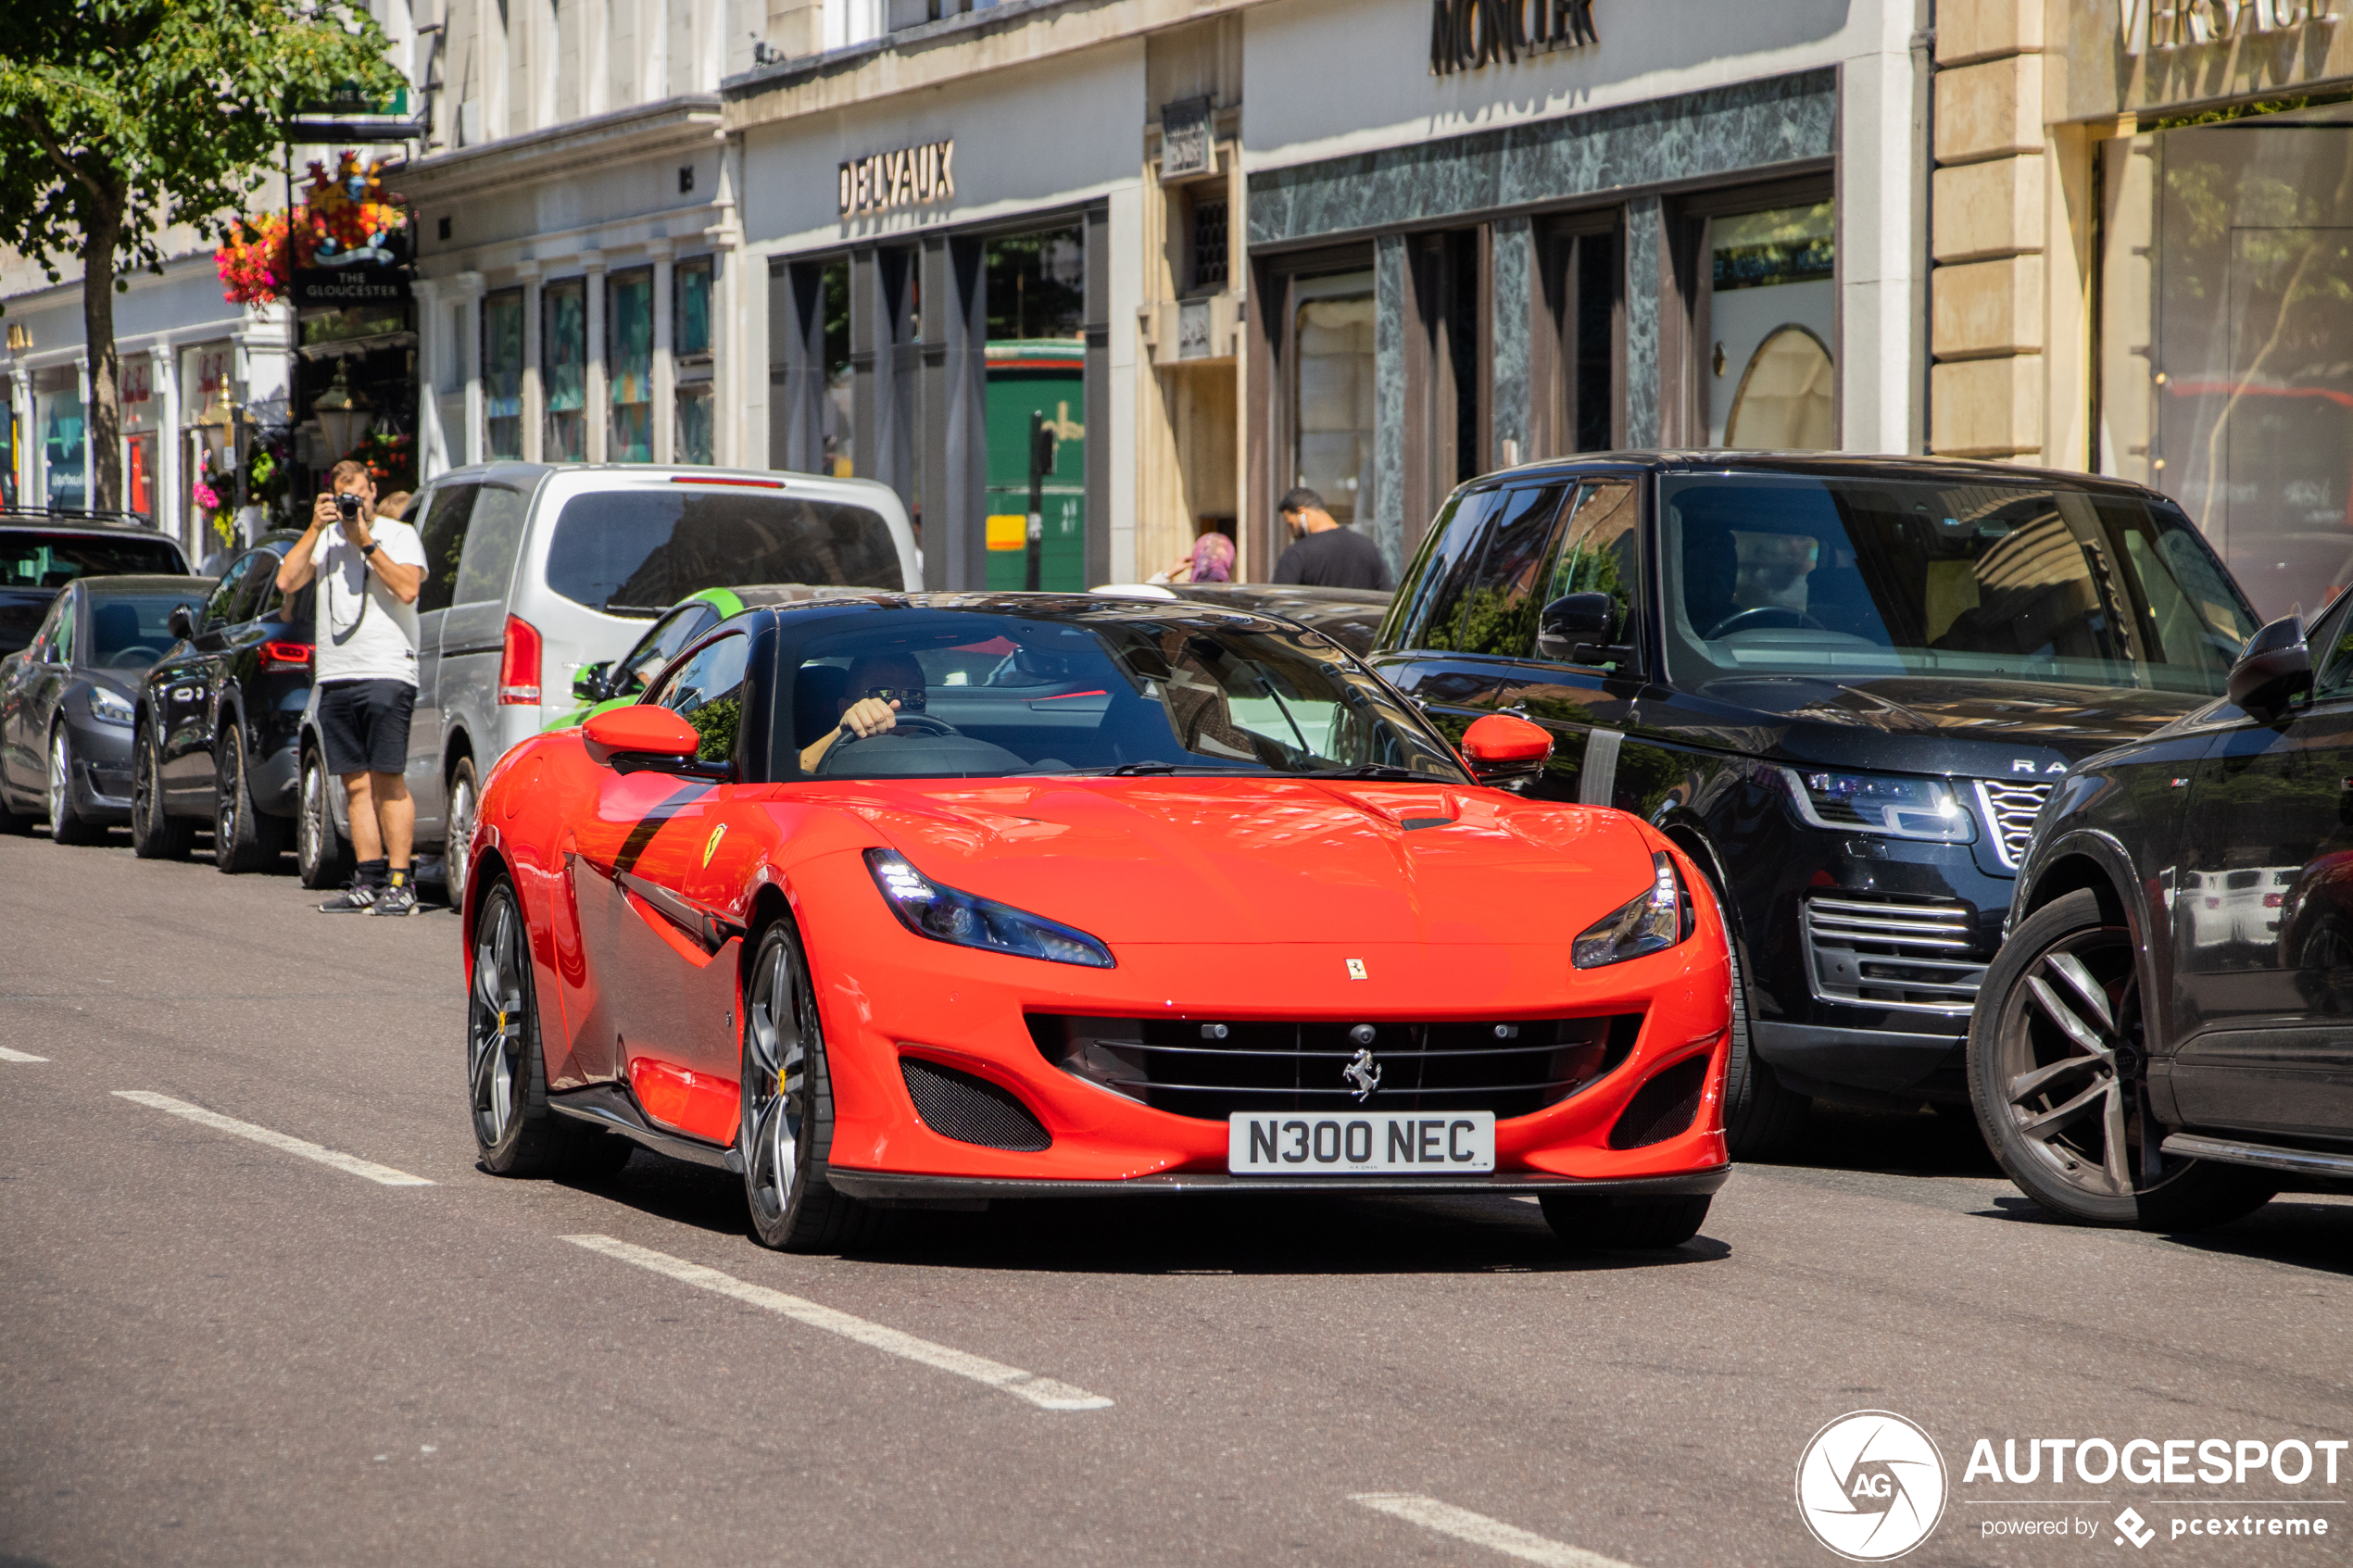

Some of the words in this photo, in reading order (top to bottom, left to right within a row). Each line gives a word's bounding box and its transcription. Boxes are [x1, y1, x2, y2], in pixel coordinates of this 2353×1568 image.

[838, 140, 954, 220] DELVAUX
[307, 284, 398, 297] GLOUCESTER
[338, 271, 366, 283] THE
[1250, 1121, 1373, 1163] N300
[1388, 1120, 1476, 1163] NEC
